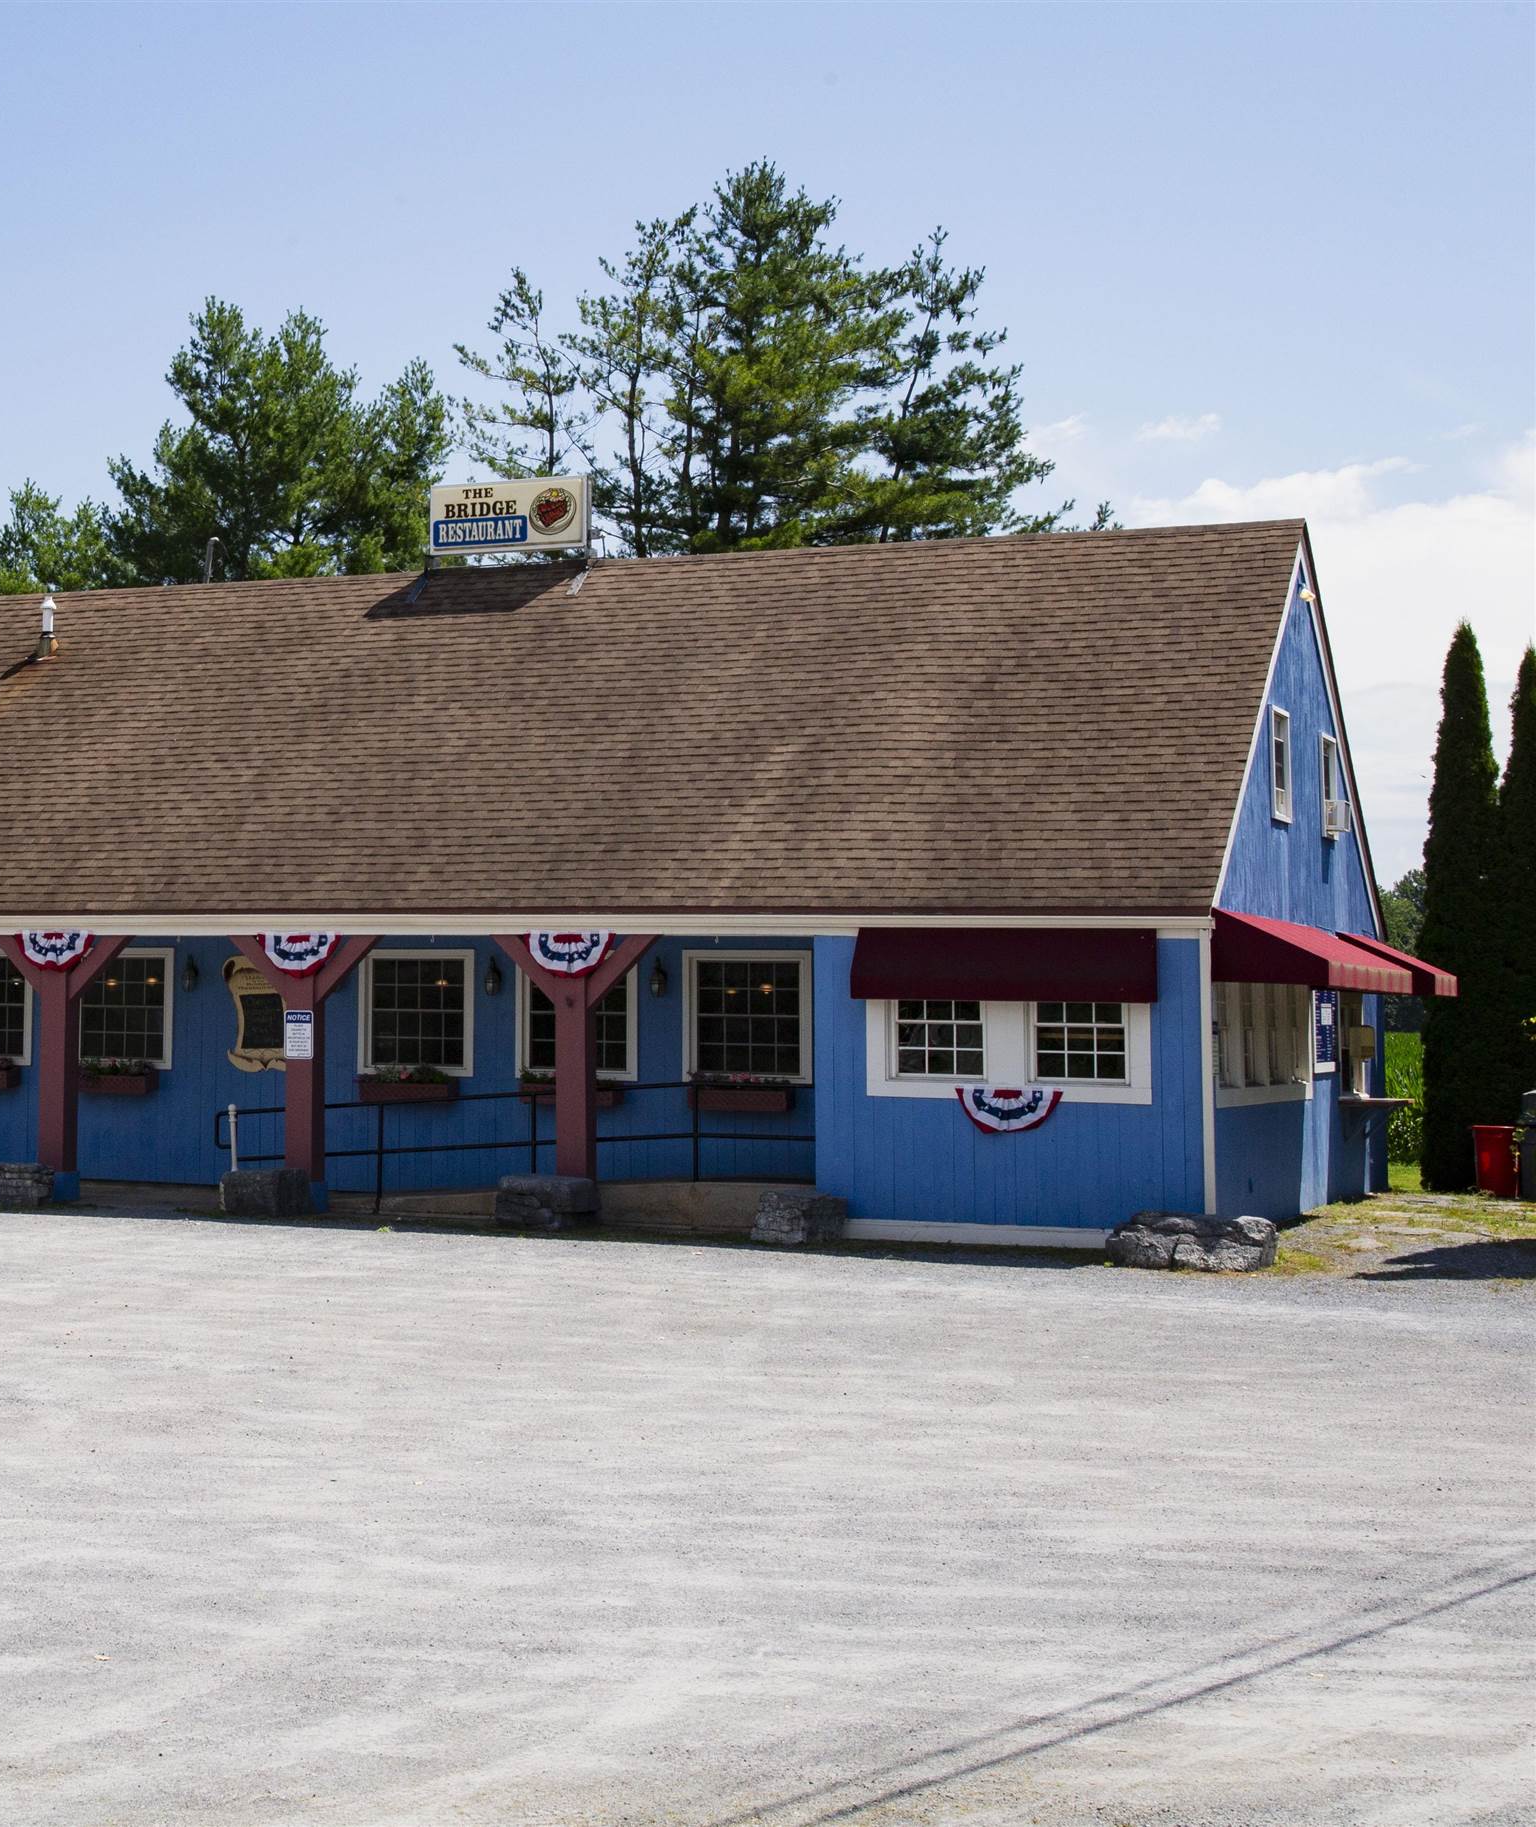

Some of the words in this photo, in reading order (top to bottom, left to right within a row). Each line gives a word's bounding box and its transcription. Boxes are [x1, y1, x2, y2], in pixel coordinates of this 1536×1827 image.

[462, 487, 494, 500] THE
[444, 500, 517, 519] BRIDGE
[438, 519, 522, 543] RESTAURANT
[287, 1014, 311, 1022] NOTICE
